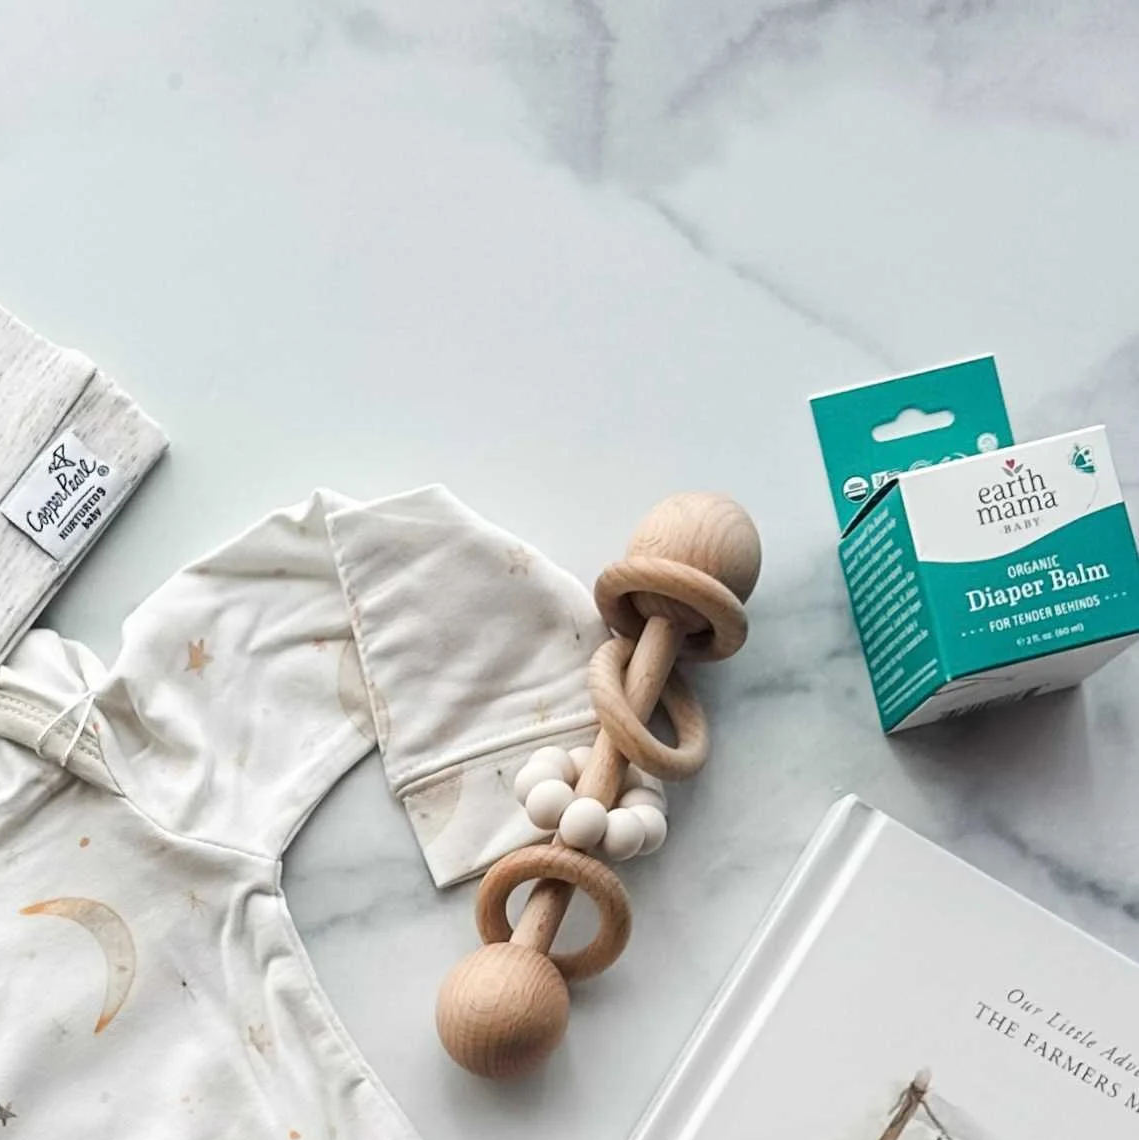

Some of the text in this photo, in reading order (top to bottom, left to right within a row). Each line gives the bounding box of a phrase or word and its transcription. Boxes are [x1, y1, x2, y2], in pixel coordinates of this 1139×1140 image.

[26, 459, 97, 533] Copper Pearl
[978, 468, 1046, 504] earth
[976, 490, 1058, 525] mama
[1003, 517, 1040, 534] BABY
[1007, 554, 1060, 578] ORGANIC
[965, 562, 1110, 612] Diaper Balm
[989, 594, 1101, 633] FOR TENDER BEHINDS
[1007, 988, 1043, 1016] Our
[1046, 1012, 1097, 1049] Little
[974, 1001, 1020, 1039] THE
[1023, 1032, 1122, 1098] FARMERS
